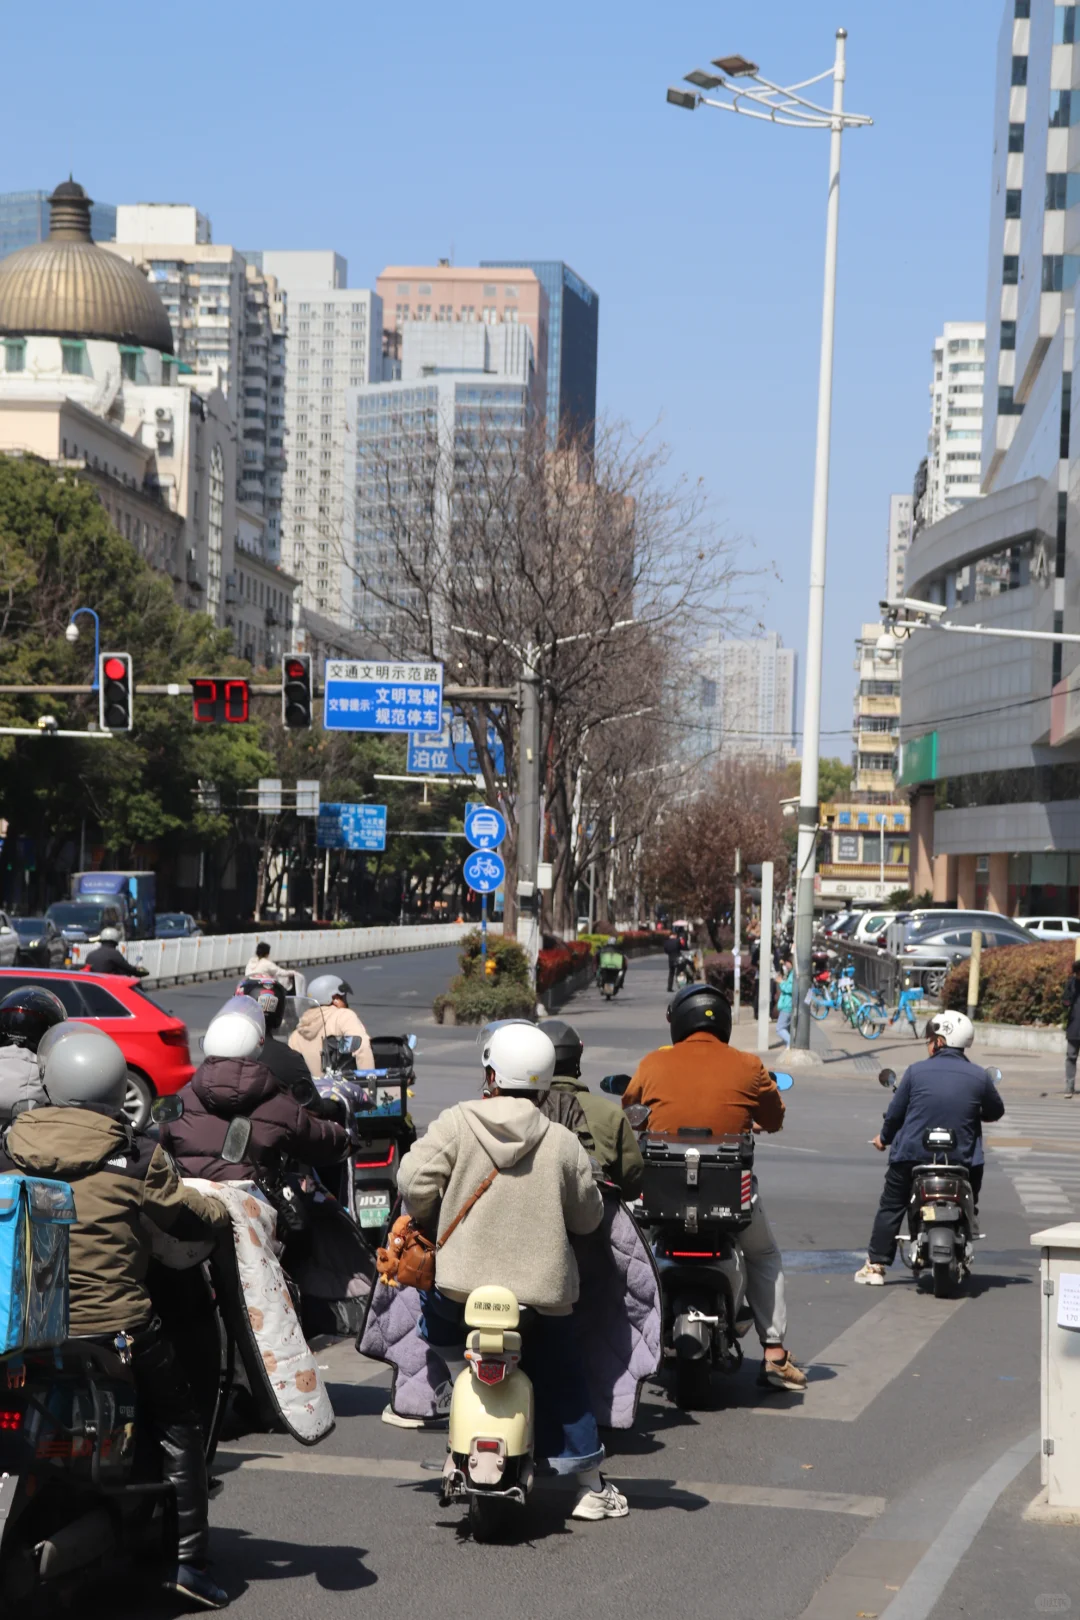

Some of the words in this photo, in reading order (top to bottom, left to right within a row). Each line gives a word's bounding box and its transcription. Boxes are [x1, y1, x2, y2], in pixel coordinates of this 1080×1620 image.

[330, 664, 438, 681] 交通文明示范路
[193, 679, 248, 722] 20
[375, 687, 438, 706] 文明驾驶
[375, 708, 438, 726] 规范停车
[413, 750, 448, 768] 泊位
